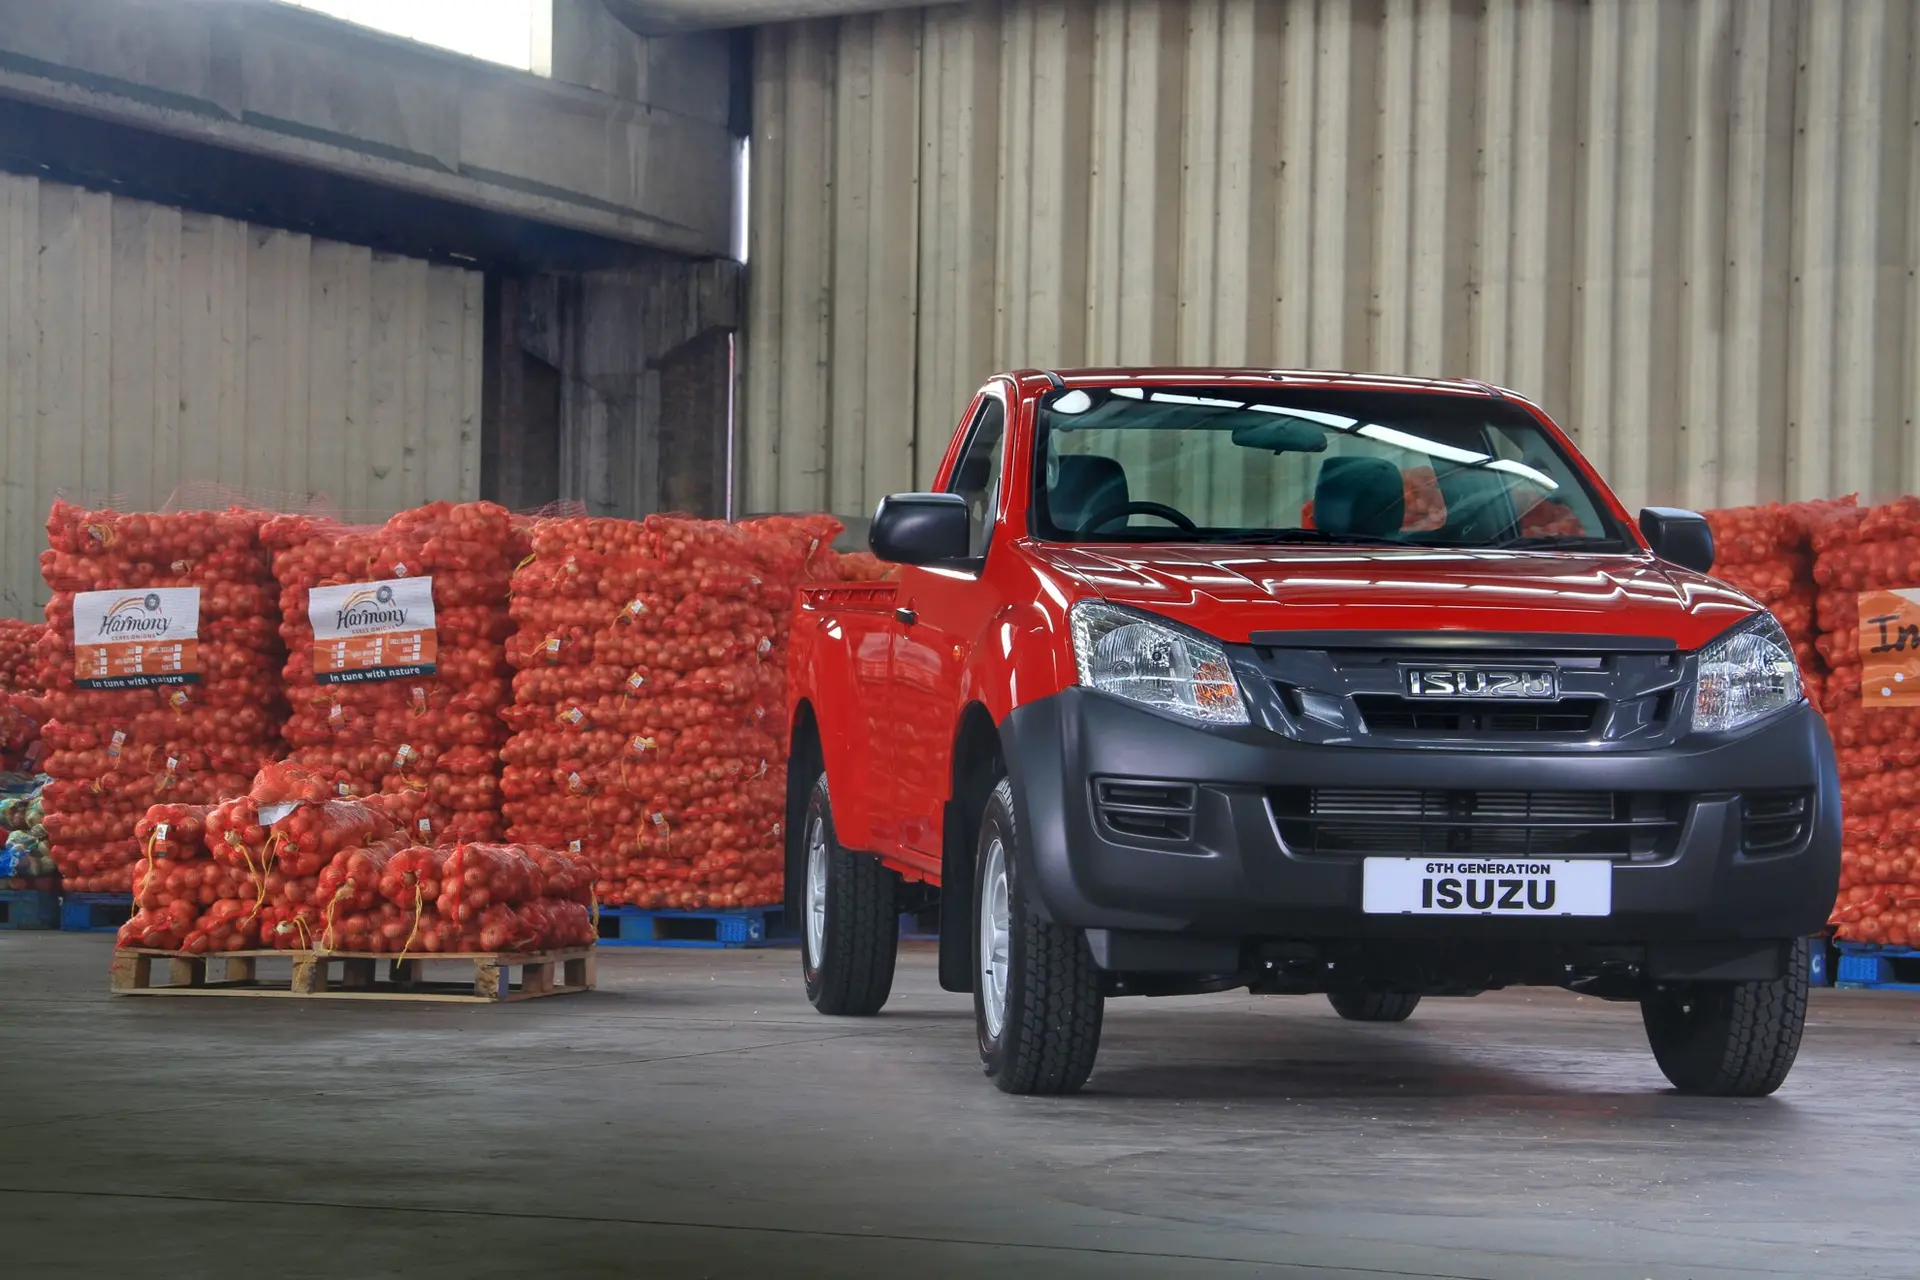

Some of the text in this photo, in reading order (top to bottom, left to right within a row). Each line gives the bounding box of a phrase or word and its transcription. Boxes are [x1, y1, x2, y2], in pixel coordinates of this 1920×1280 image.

[98, 614, 172, 636] Harmony
[336, 607, 408, 629] Harmony
[104, 680, 125, 688] tune
[127, 677, 148, 686] with
[151, 676, 184, 684] nature
[342, 673, 363, 681] tune
[365, 669, 386, 679] with
[389, 667, 420, 676] nature
[1410, 672, 1551, 696] ISUZU
[1426, 863, 1551, 875] 6TH GENERATION
[1422, 878, 1556, 910] ISUZU
